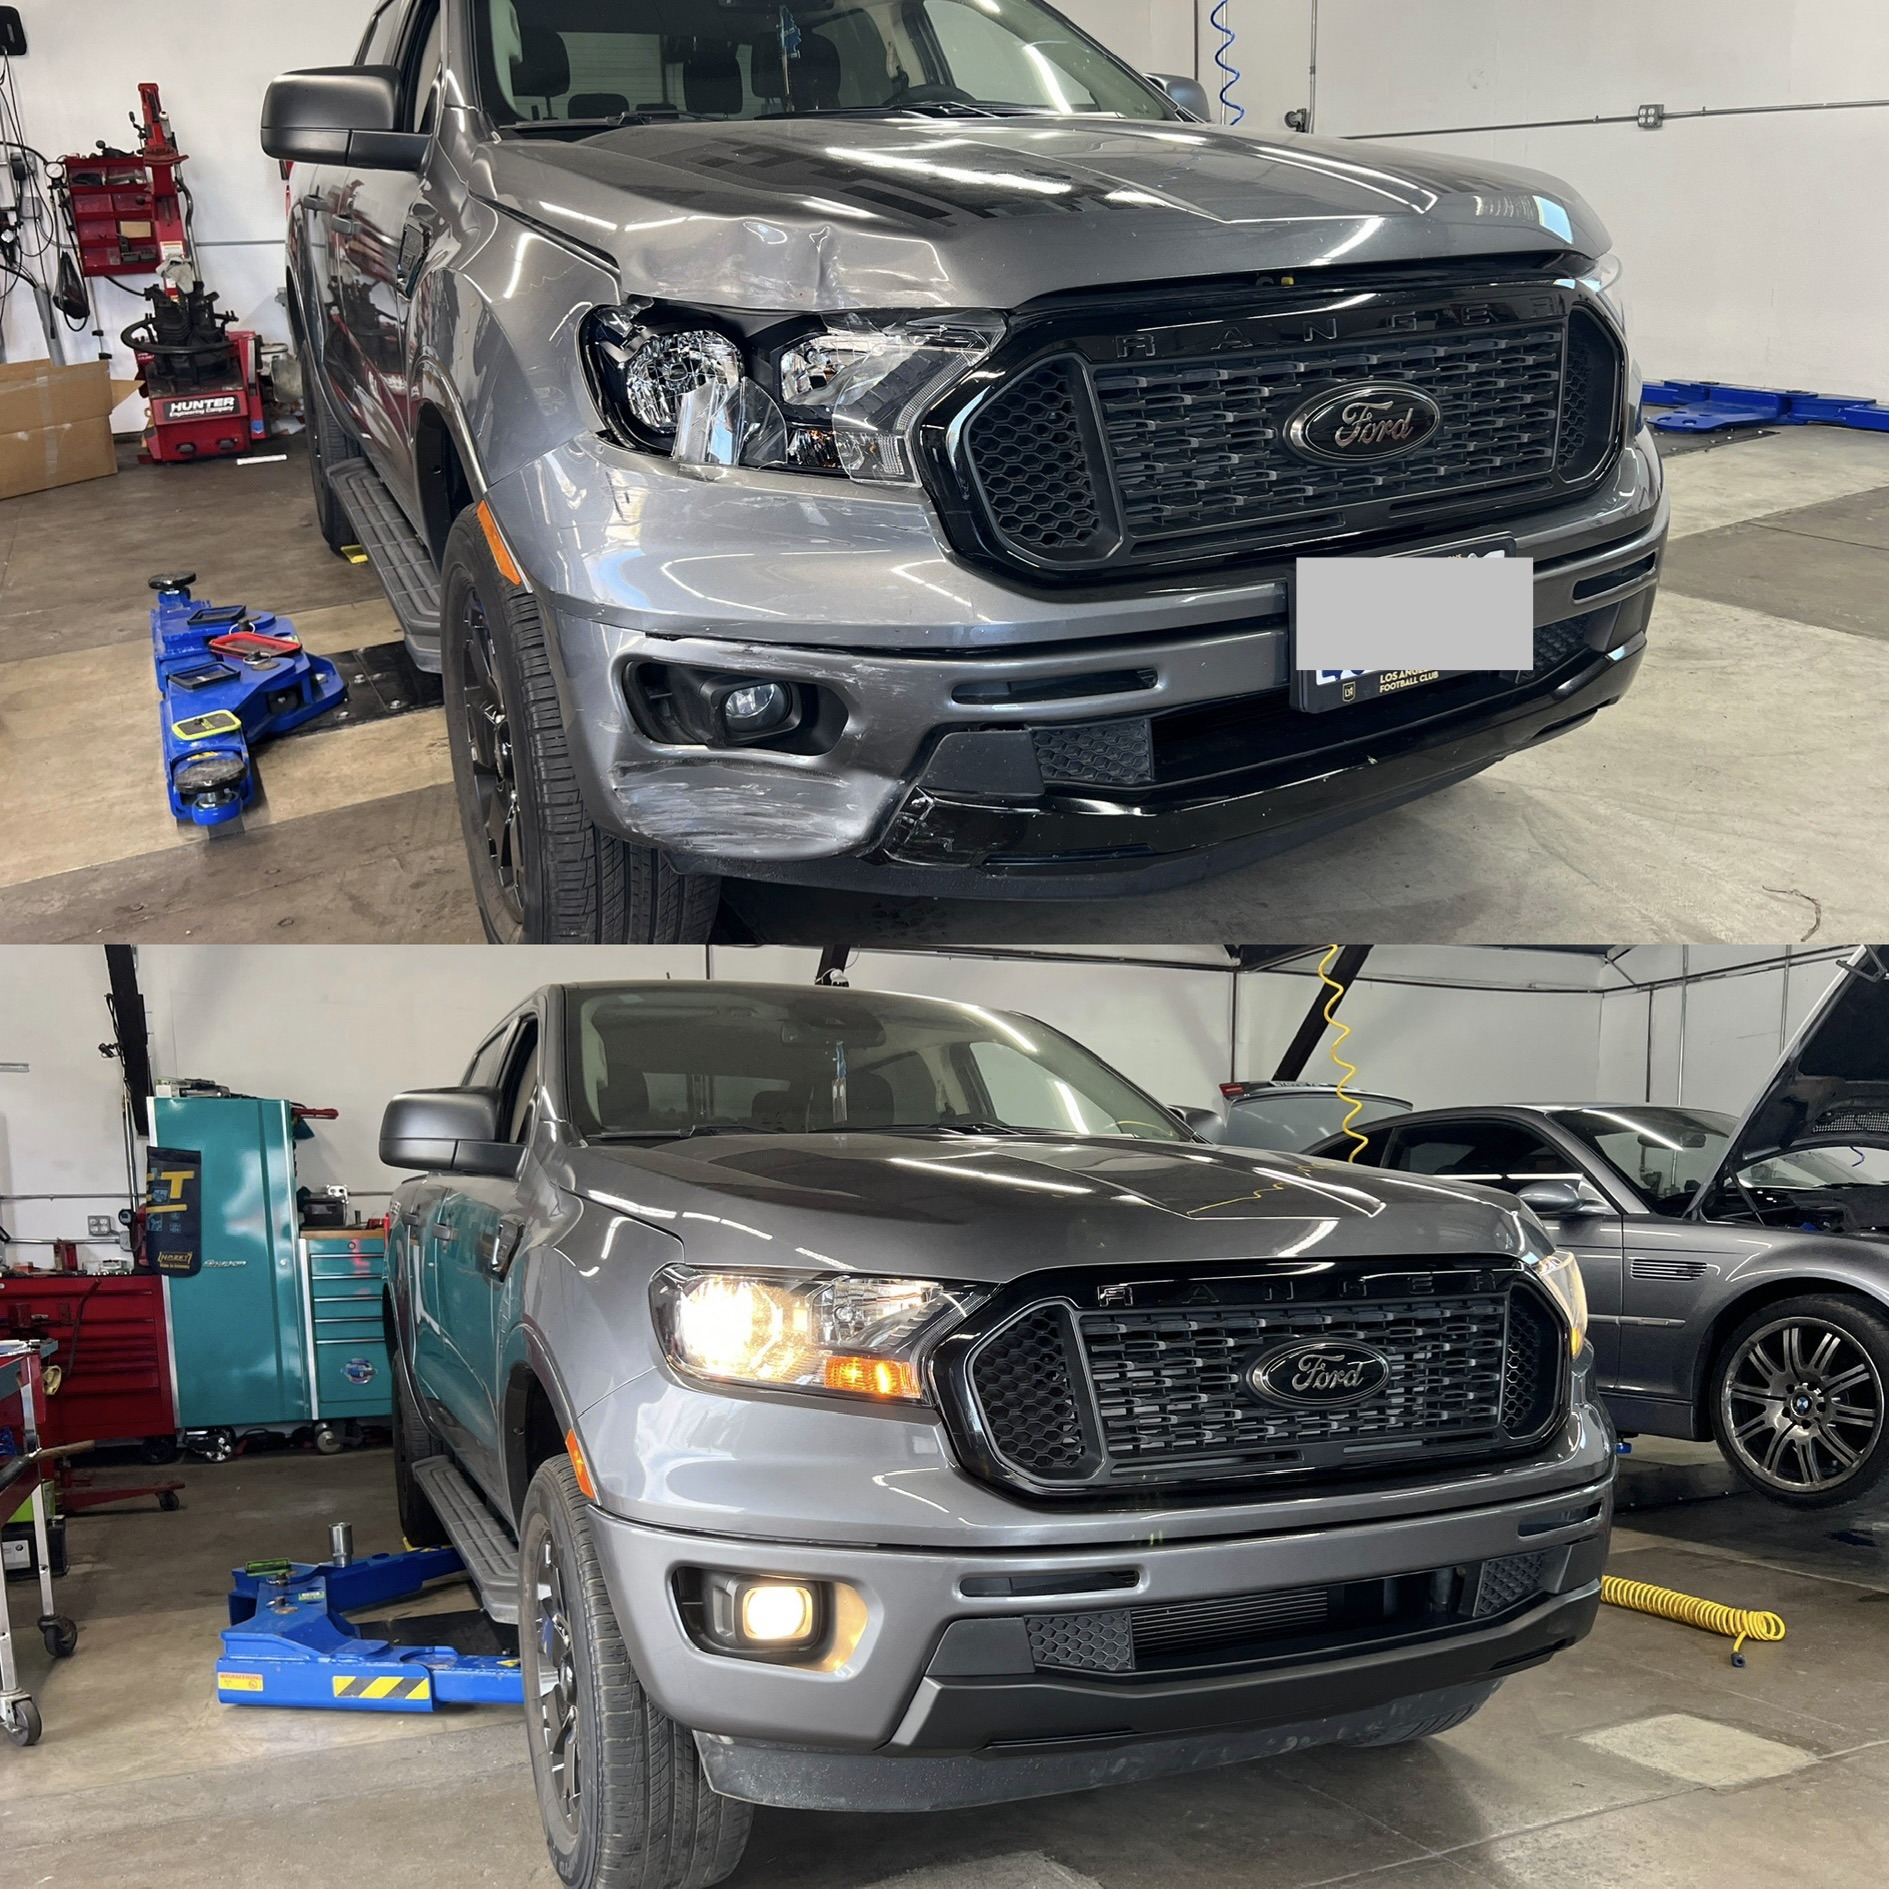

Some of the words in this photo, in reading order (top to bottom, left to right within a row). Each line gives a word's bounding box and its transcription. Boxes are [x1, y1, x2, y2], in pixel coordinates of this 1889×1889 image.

[171, 397, 235, 412] HUNTER
[1334, 400, 1414, 447] Ford
[1379, 676, 1418, 693] FOOTBALL
[1419, 670, 1439, 682] CLUB
[1380, 671, 1398, 684] LOS
[1292, 1354, 1364, 1392] Ford
